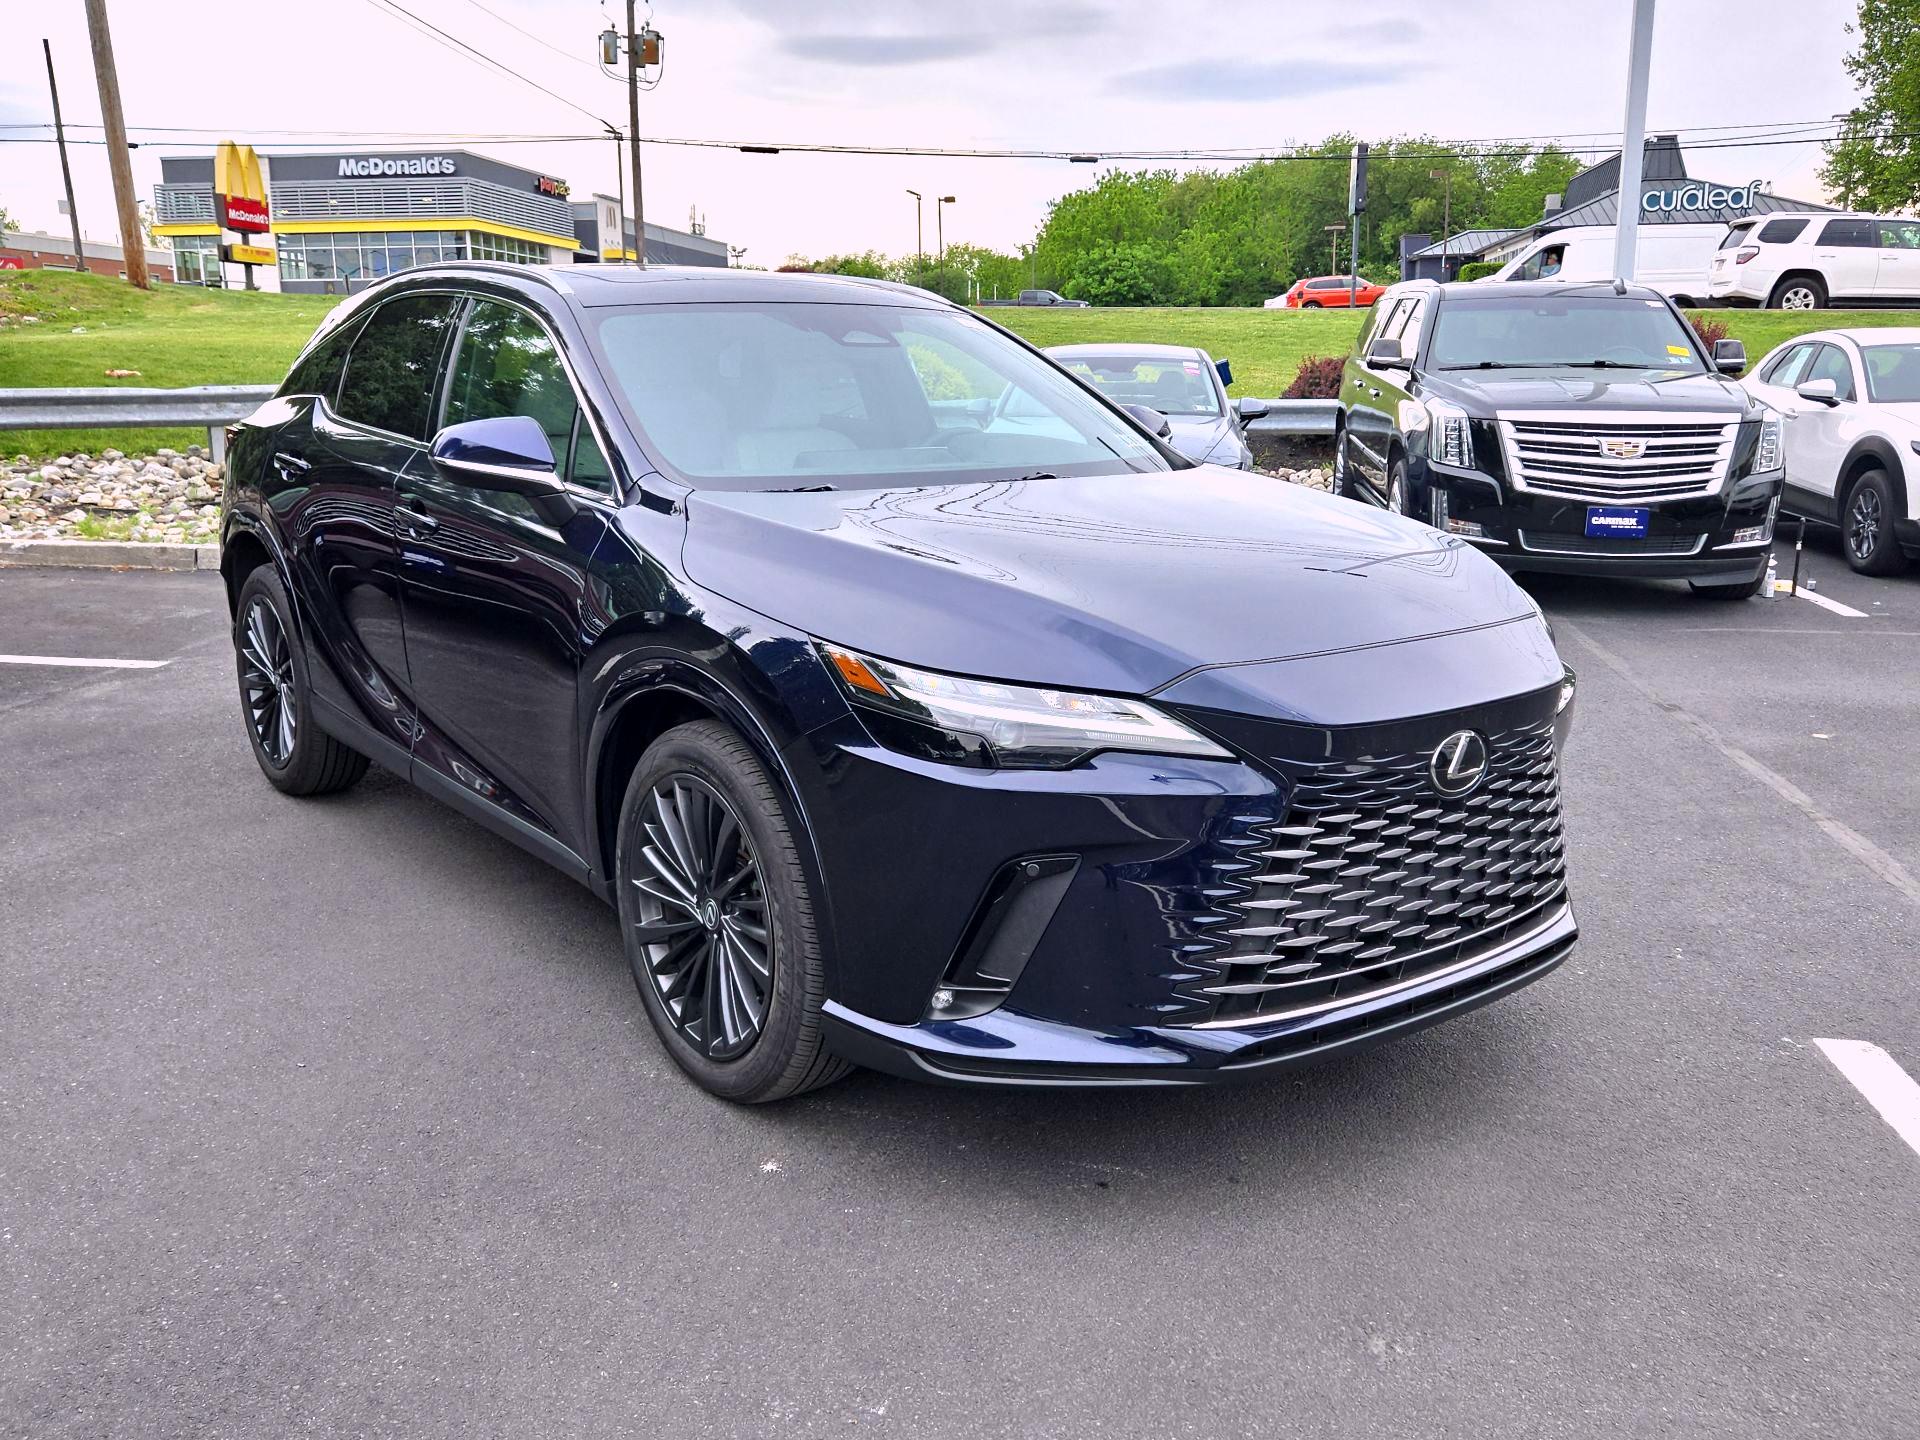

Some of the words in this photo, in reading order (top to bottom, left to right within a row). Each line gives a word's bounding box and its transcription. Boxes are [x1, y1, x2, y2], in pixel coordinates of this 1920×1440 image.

[339, 157, 456, 176] McDonald's
[1641, 180, 1762, 212] curaleaf
[229, 208, 269, 224] McDonald's
